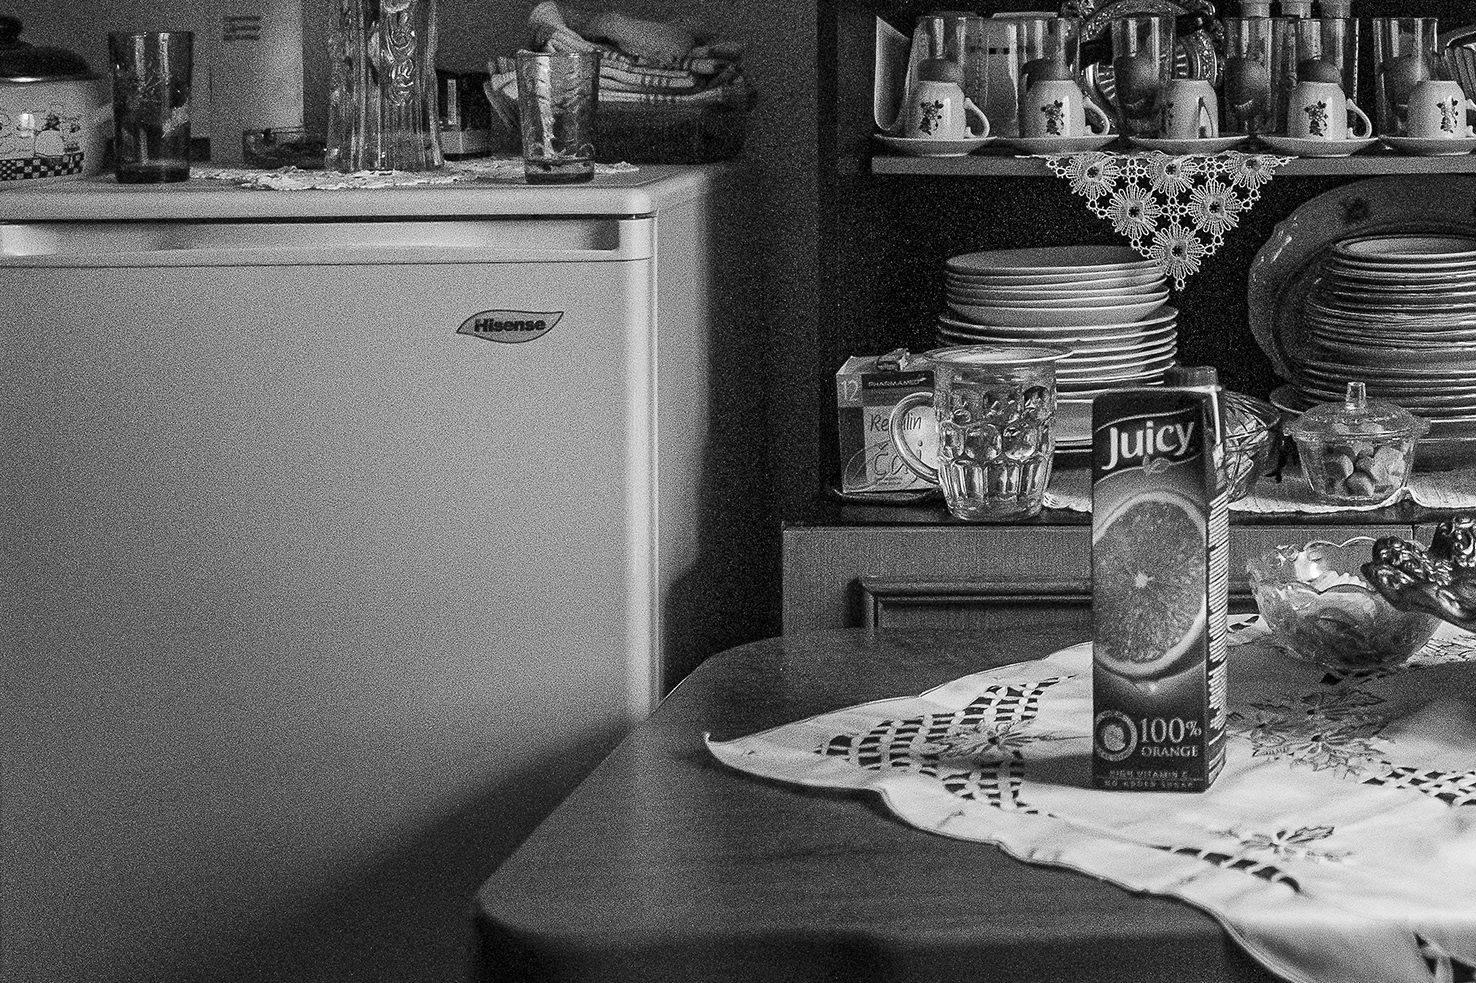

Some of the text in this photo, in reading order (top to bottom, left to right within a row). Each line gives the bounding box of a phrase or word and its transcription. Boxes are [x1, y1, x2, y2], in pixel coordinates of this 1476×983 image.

[474, 318, 547, 333] Hisense
[841, 379, 859, 402] 12
[1101, 420, 1195, 470] Juicy
[1140, 717, 1202, 744] 100%
[1141, 746, 1198, 757] ORANGE
